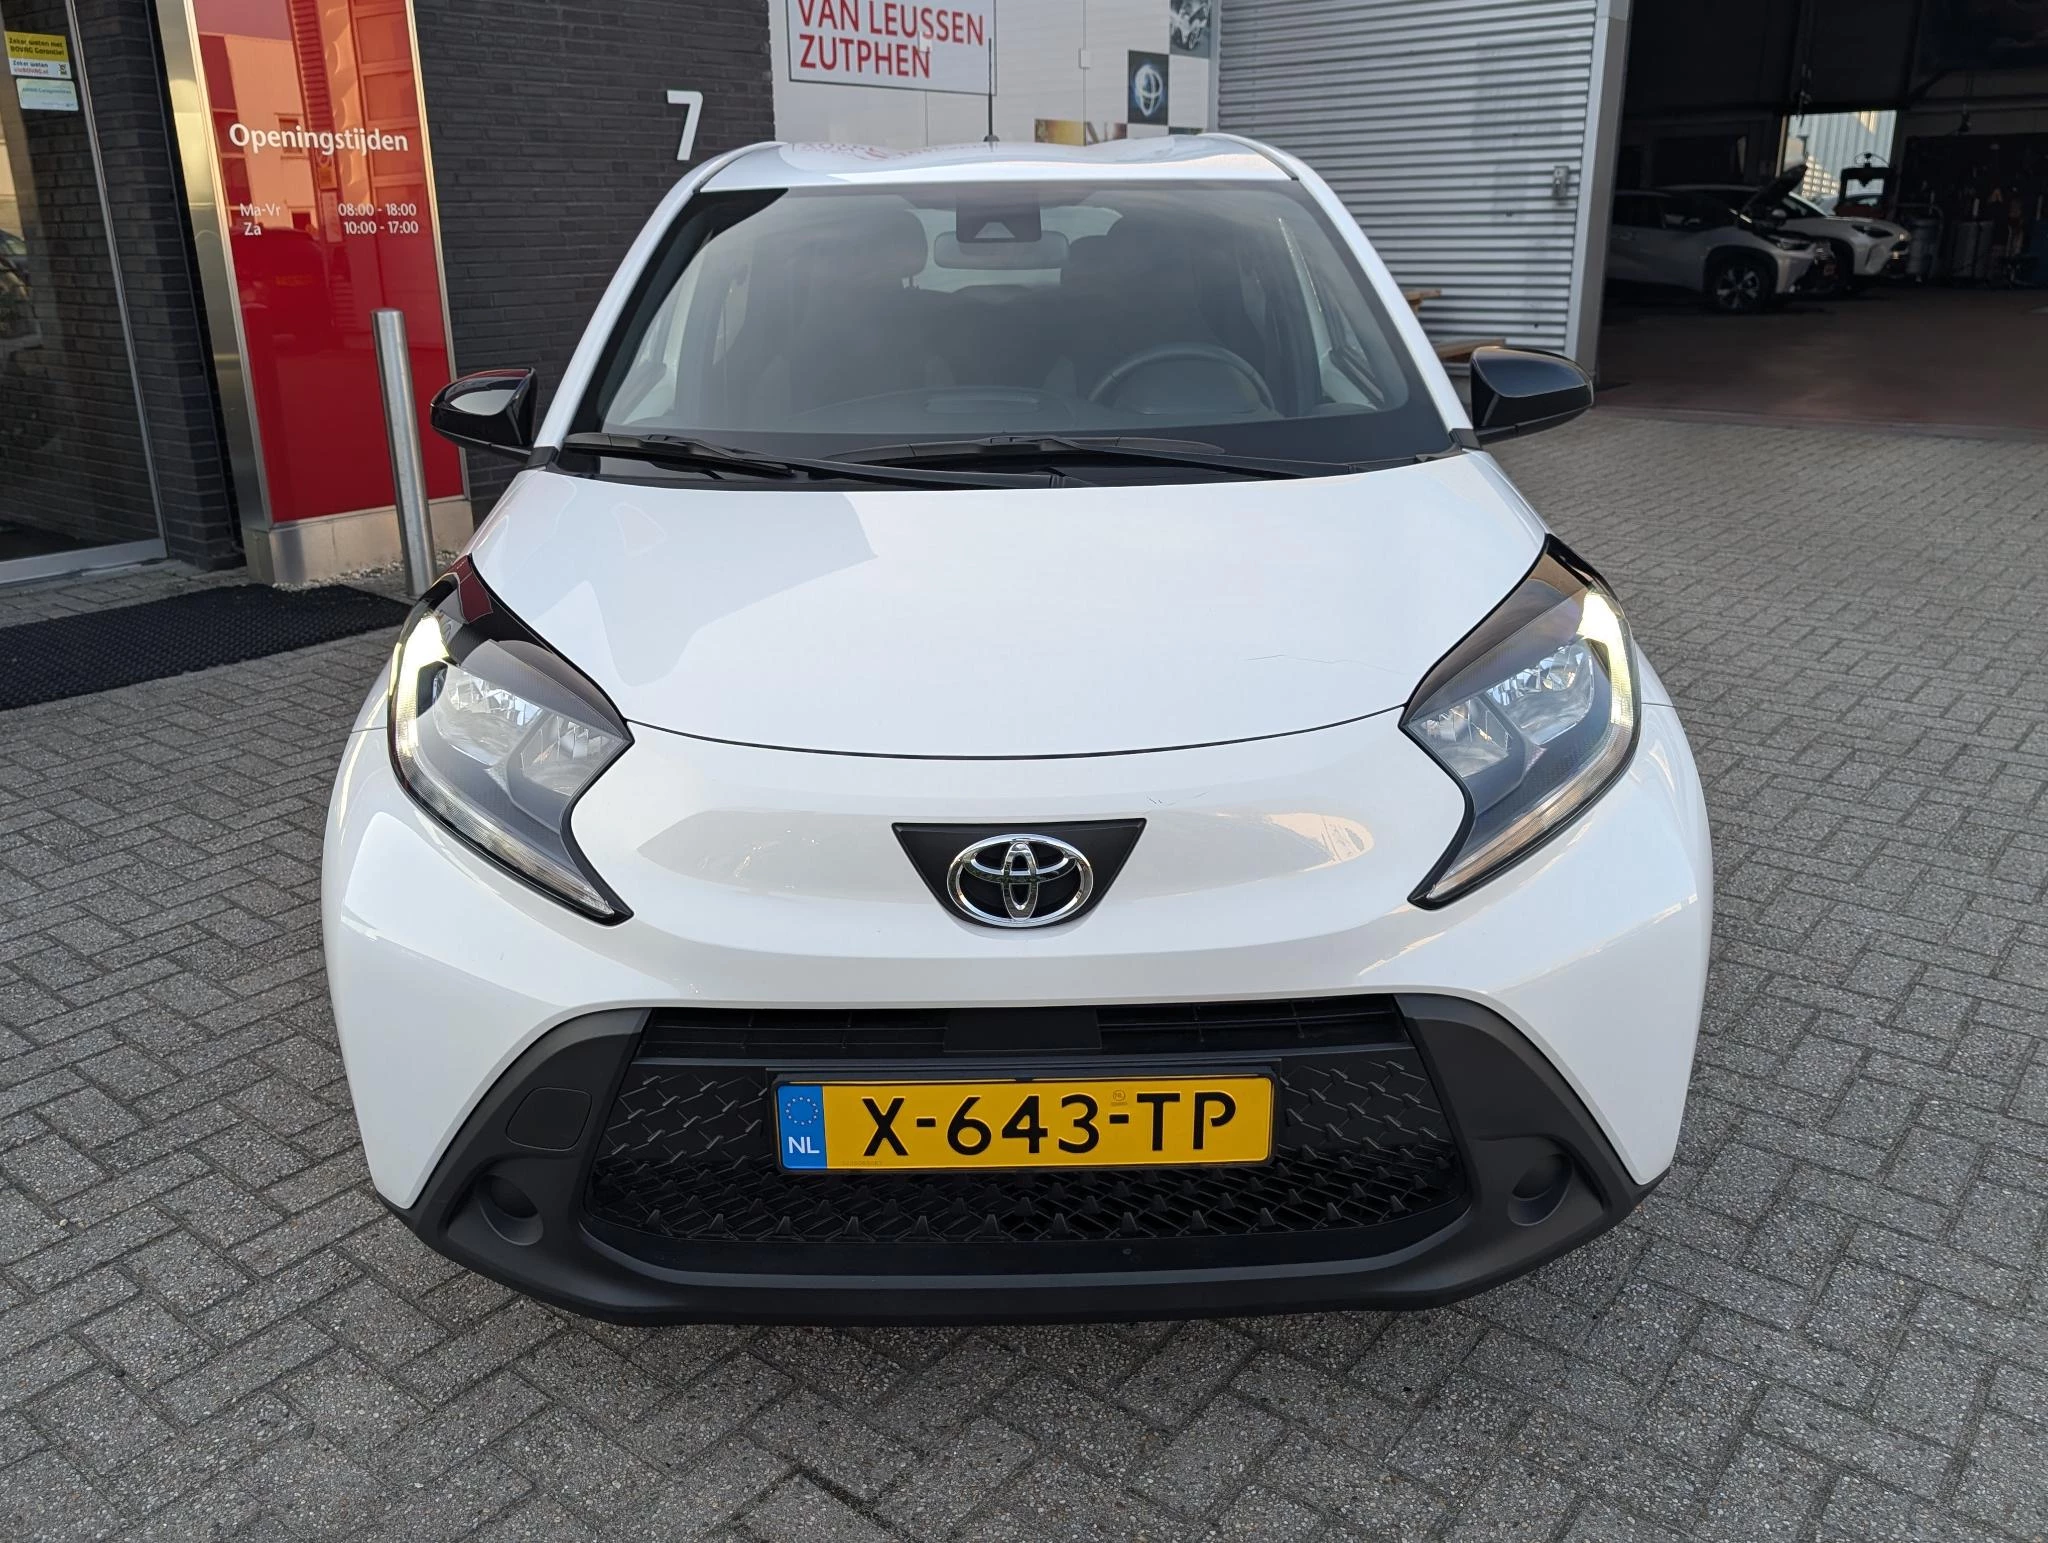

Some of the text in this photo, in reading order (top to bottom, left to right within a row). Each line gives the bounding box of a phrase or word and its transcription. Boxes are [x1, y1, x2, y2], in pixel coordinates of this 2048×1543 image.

[799, 0, 984, 46] VAN LEUSSEN
[799, 33, 930, 79] ZUTPHEN
[229, 123, 408, 156] Openingstijden
[667, 90, 703, 160] 7
[240, 203, 281, 217] Ma-Vr
[338, 203, 375, 217] 08:00
[385, 203, 417, 217] 18:00
[243, 221, 262, 236] Za
[343, 221, 377, 235] 10:00
[388, 221, 419, 235] 17:00
[788, 1090, 1236, 1157] NL X-643-TP
